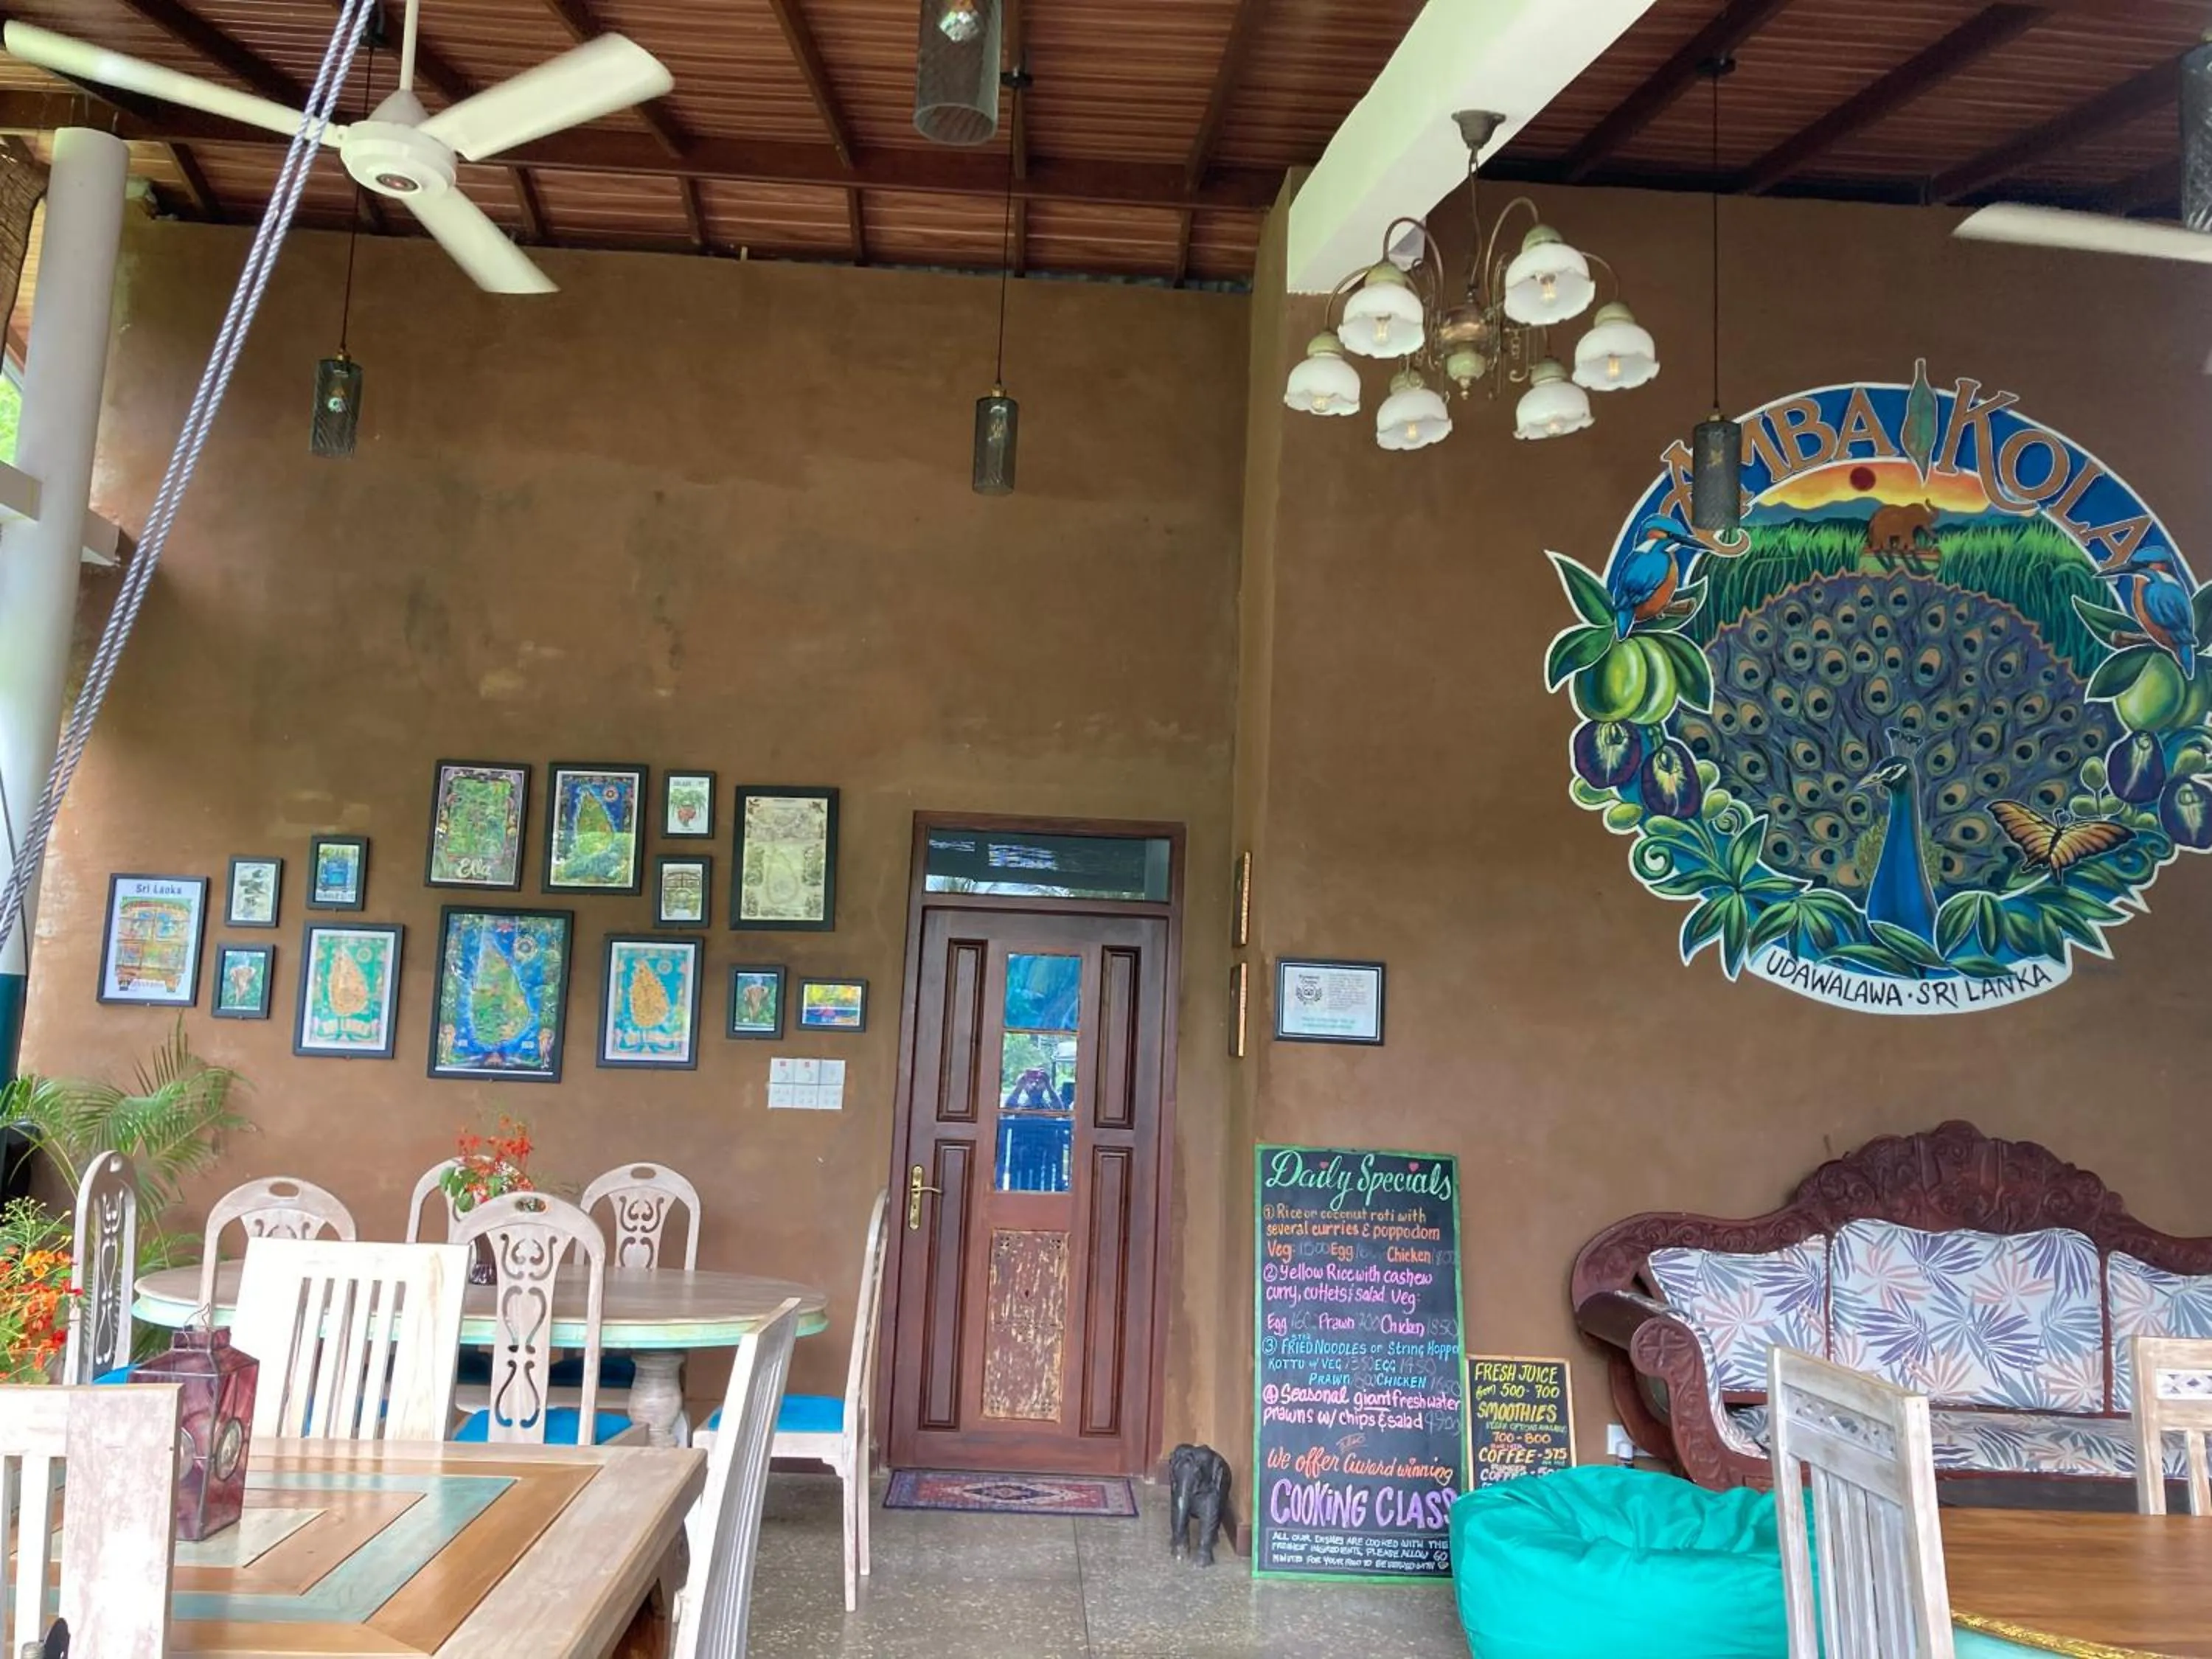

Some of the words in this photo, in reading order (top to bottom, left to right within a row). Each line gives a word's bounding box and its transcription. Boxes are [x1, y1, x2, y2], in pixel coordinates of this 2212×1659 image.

[1933, 377, 2154, 572] KOLA
[456, 858, 490, 878] Ella
[136, 884, 150, 894] Sri
[153, 885, 182, 895] Lanka
[1767, 950, 1902, 1006] UDAWALAWA
[1916, 981, 1959, 1008] SRI
[1967, 964, 2052, 1002] LANKA
[1265, 1150, 1354, 1211] Daily
[1357, 1153, 1452, 1207] Specials
[1276, 1203, 1304, 1220] Rice
[1304, 1210, 1318, 1219] or
[1321, 1208, 1367, 1221] coconut
[1371, 1209, 1395, 1222] roti
[1397, 1207, 1427, 1224] with
[1265, 1221, 1308, 1237] several
[1312, 1221, 1359, 1237] curries
[1331, 1242, 1354, 1262] Egg
[1386, 1245, 1431, 1264] Chicken
[1280, 1261, 1324, 1281] Yellow
[1327, 1261, 1355, 1278] Rice
[1355, 1262, 1380, 1283] with
[1383, 1267, 1433, 1287] cashew
[1266, 1285, 1302, 1308] curry,
[1267, 1312, 1287, 1335] Egg
[1318, 1312, 1355, 1330] Prawn
[1380, 1312, 1425, 1337] Chicken
[1281, 1338, 1313, 1354] FRIED
[1315, 1340, 1366, 1355] NOODLES
[1370, 1344, 1382, 1354] or
[1387, 1340, 1425, 1359] String
[1267, 1357, 1304, 1370] KOTTU
[1321, 1358, 1342, 1370] VEG
[1374, 1358, 1397, 1372] EGG
[1474, 1362, 1517, 1382] FRESH
[1519, 1364, 1558, 1384] JUICE
[1309, 1372, 1351, 1385] PRAWN
[1376, 1373, 1427, 1388] CHICKEN
[1280, 1383, 1349, 1405] Seasonal
[1353, 1389, 1392, 1412] giant
[1534, 1384, 1560, 1399] 700
[1263, 1406, 1313, 1426] prawns
[1318, 1408, 1337, 1428] w/
[1338, 1410, 1375, 1430] chips
[1387, 1412, 1424, 1430] salad
[1477, 1400, 1558, 1423] SMOOTHIES
[1267, 1446, 1291, 1469] We
[1295, 1445, 1340, 1478] offer
[1397, 1456, 1454, 1486] winning
[1478, 1446, 1537, 1464] COFFEE
[1375, 1486, 1457, 1530] CLASS
[1272, 1531, 1290, 1541] ALL
[1291, 1534, 1312, 1543] OUR
[1315, 1534, 1344, 1545] DISHES
[1346, 1536, 1363, 1547] ARE
[1365, 1537, 1399, 1548] COOKED
[1400, 1538, 1425, 1549] WITH
[1428, 1540, 1450, 1550] THE
[1306, 1554, 1323, 1564] FOR
[1366, 1547, 1401, 1559] PLEASE
[1401, 1549, 1429, 1559] ALLOW
